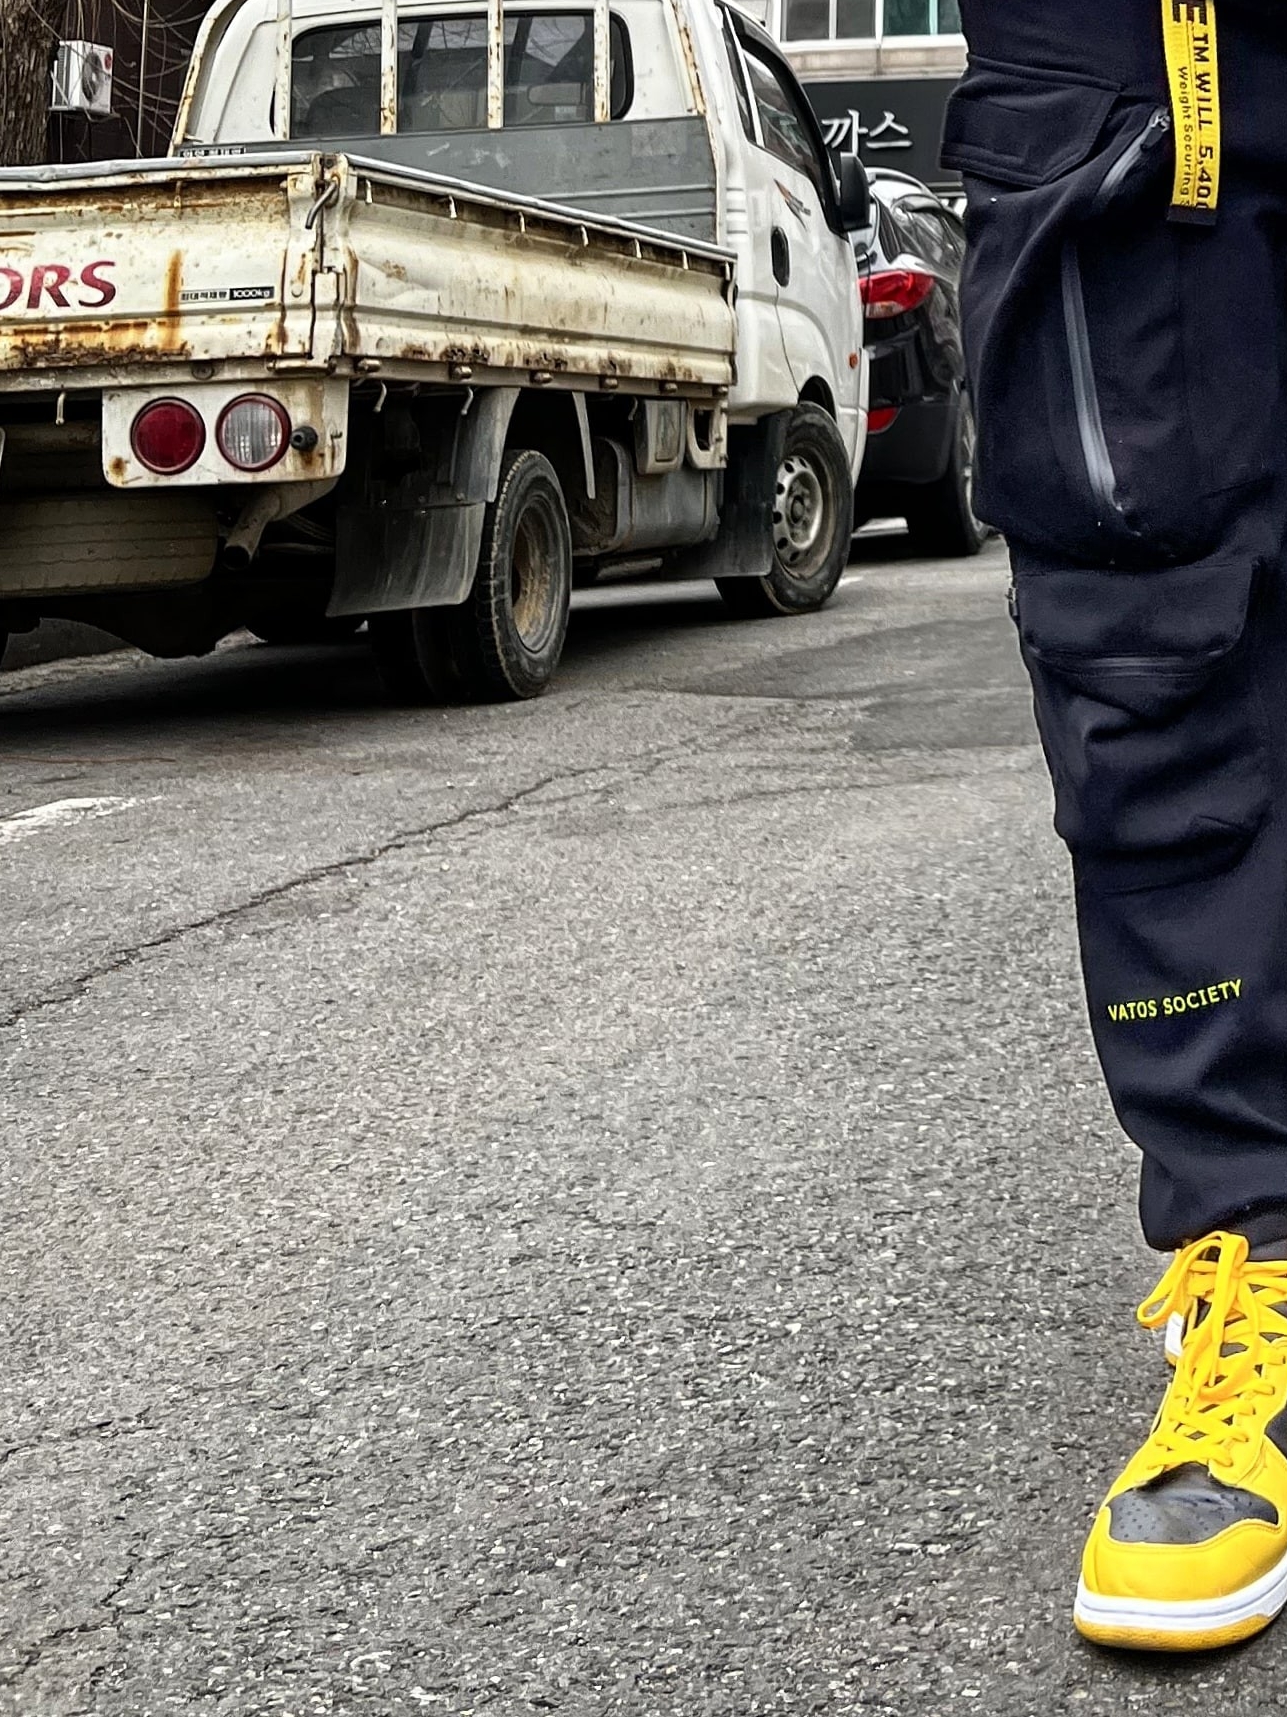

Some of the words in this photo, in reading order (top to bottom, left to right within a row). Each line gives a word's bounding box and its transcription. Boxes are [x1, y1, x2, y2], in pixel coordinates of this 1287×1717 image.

[1177, 66, 1192, 120] Weight
[1194, 72, 1213, 131] WILL
[233, 289, 270, 298] 1000kg
[1107, 999, 1157, 1021] VATOS
[1162, 979, 1242, 1016] SOCIETY
